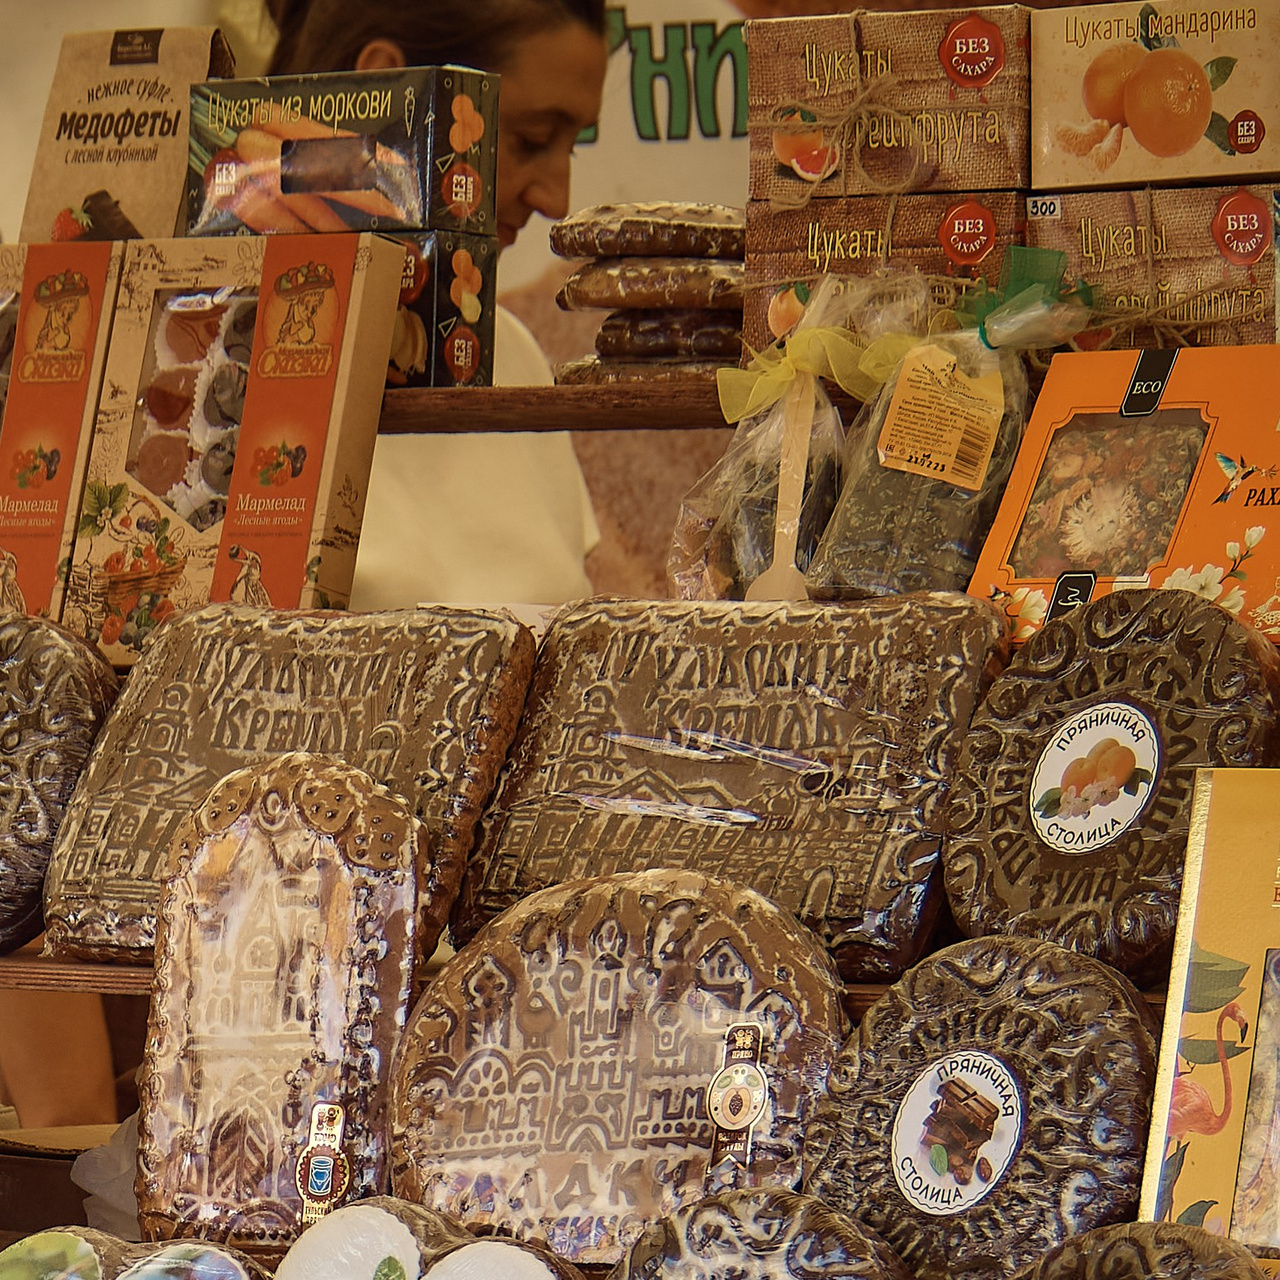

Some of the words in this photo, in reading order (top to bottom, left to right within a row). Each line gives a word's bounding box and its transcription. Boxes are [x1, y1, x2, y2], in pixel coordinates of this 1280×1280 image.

[1065, 16, 1140, 48] Цукаты
[1149, 8, 1256, 43] мандарина
[955, 37, 990, 54] БЕЗ
[805, 43, 892, 97] Цукаты
[951, 54, 995, 76] САХАРА
[87, 77, 134, 104] нежное
[137, 76, 171, 103] суфле
[208, 91, 273, 135] Цукаты
[280, 95, 302, 123] из
[308, 89, 392, 135] моркови
[1237, 121, 1256, 136] БЕЗ
[72, 146, 104, 163] лесной
[106, 144, 159, 166] клубникой
[215, 162, 236, 183] БЕЗ
[452, 174, 466, 202] БЕЗ
[1030, 201, 1056, 216] 300
[954, 219, 984, 234] БЕЗ
[1226, 214, 1259, 231] БЕЗ
[808, 222, 892, 274] Цукаты
[950, 234, 988, 253] САХАРА
[1081, 217, 1167, 273] Цукаты
[1224, 232, 1264, 254] САХАРА
[454, 339, 466, 366] БЕЗ
[1132, 380, 1162, 395] ECO
[235, 493, 306, 515] Мармелад
[1244, 487, 1280, 507] РАХ
[1056, 711, 1146, 752] ПРЯНИЧНАЯ
[1047, 817, 1121, 846] СТОЛИЦА
[936, 1058, 1014, 1118] ПРЯНИЧНАЯ
[900, 1156, 963, 1205] СТОЛИЦА
